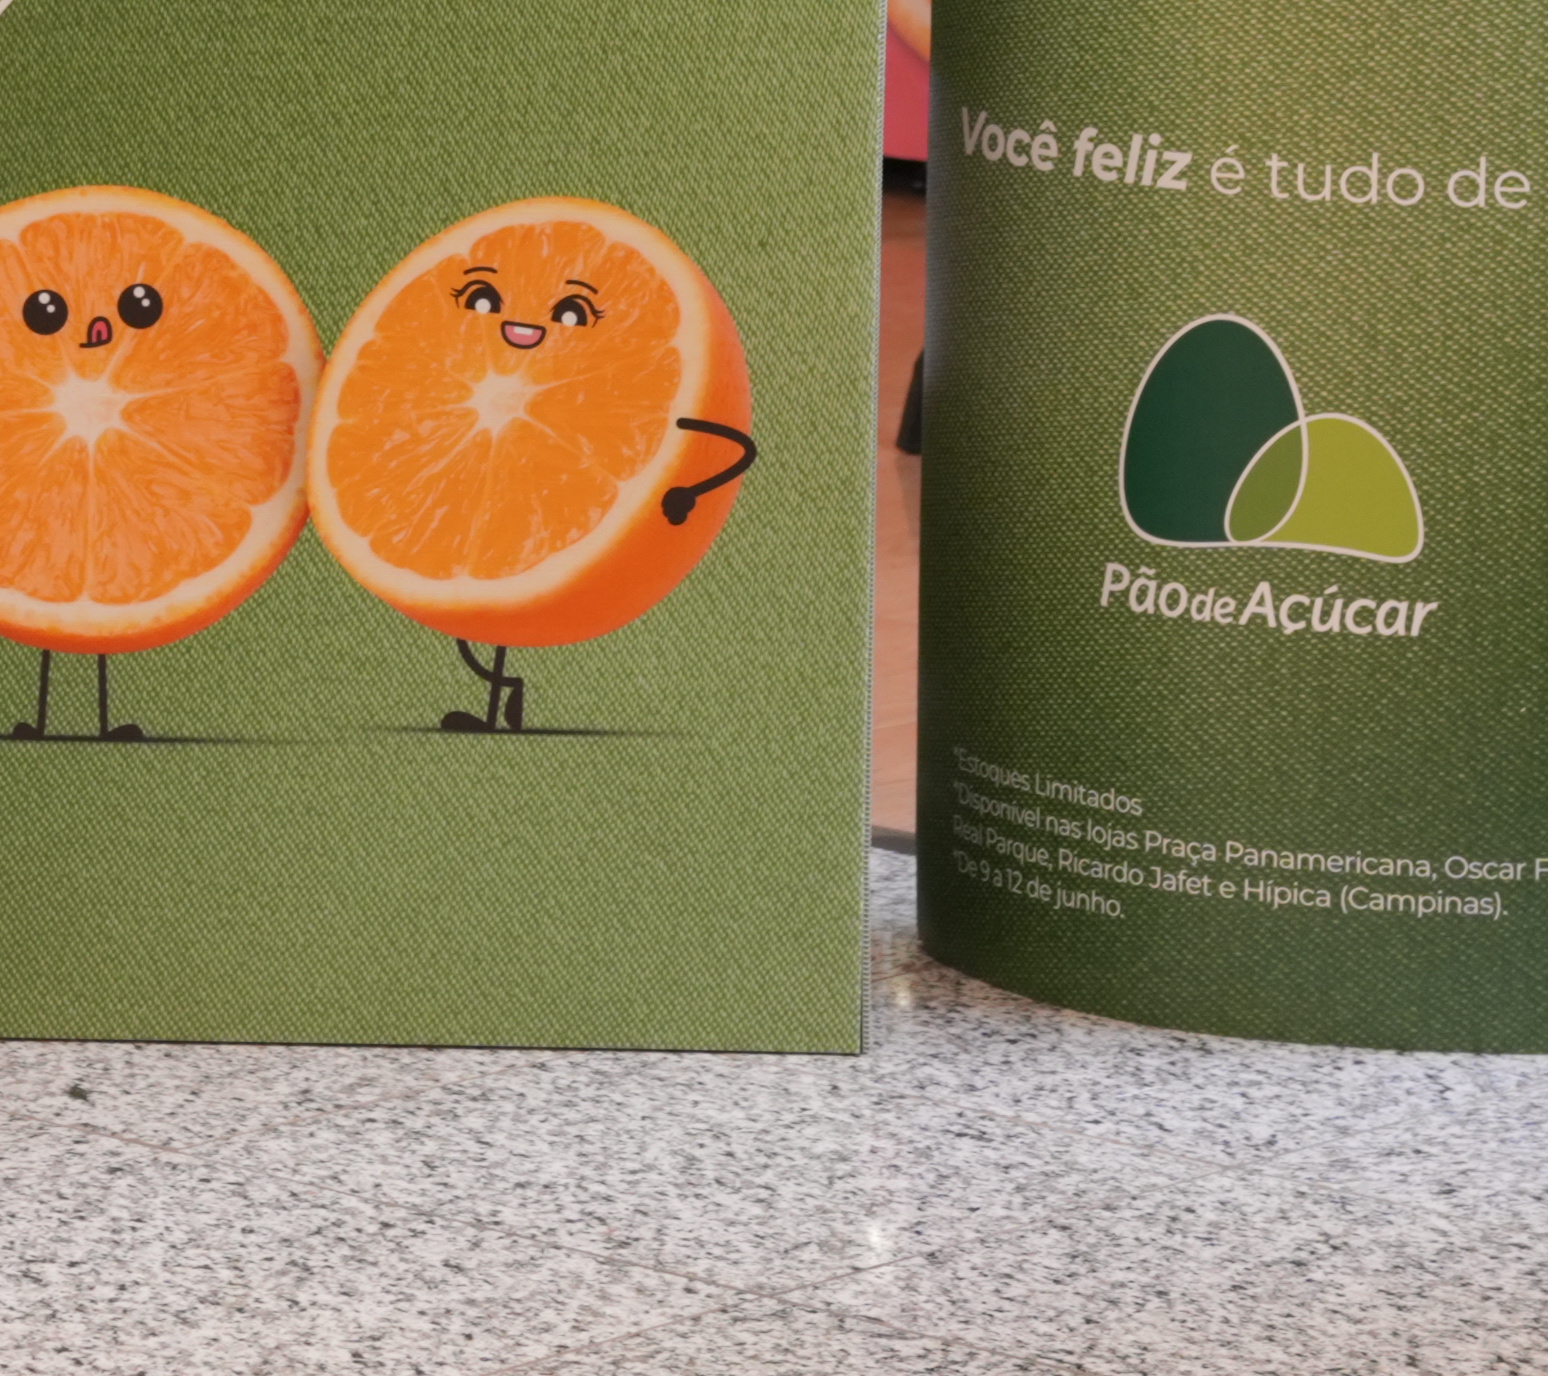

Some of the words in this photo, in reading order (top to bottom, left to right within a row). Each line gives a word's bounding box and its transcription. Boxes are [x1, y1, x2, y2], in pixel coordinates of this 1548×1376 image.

[959, 105, 1059, 173] Você
[1072, 126, 1193, 193] feliz
[1209, 144, 1247, 195] é
[1265, 152, 1425, 208] tudo
[1446, 156, 1531, 210] de
[1046, 814, 1082, 839] nas
[1087, 819, 1139, 851] lojas
[1145, 830, 1216, 866] Praça
[1225, 840, 1438, 881] Panamericana,
[1444, 854, 1526, 882] Oscar
